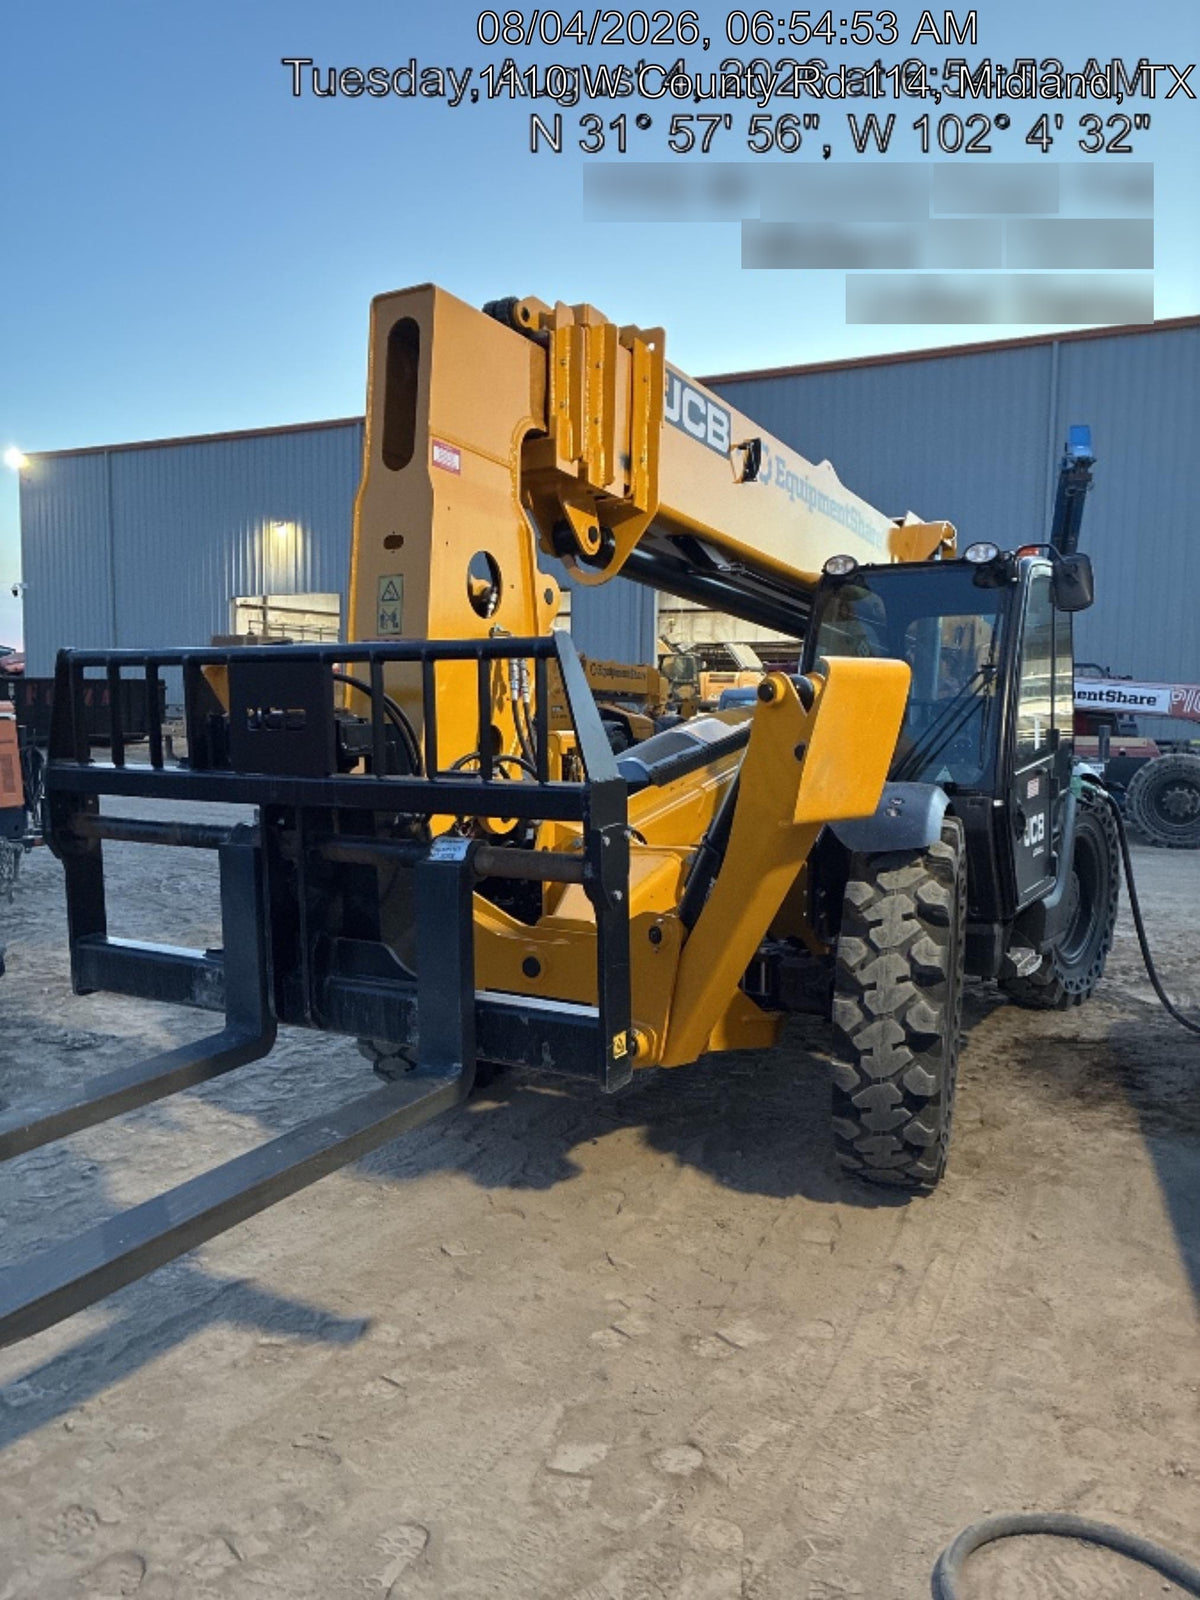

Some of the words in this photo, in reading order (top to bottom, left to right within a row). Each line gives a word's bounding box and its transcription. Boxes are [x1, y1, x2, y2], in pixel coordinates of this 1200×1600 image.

[665, 372, 730, 453] JCB
[774, 454, 884, 551] EquipmentShare
[1023, 812, 1045, 847] JCB
